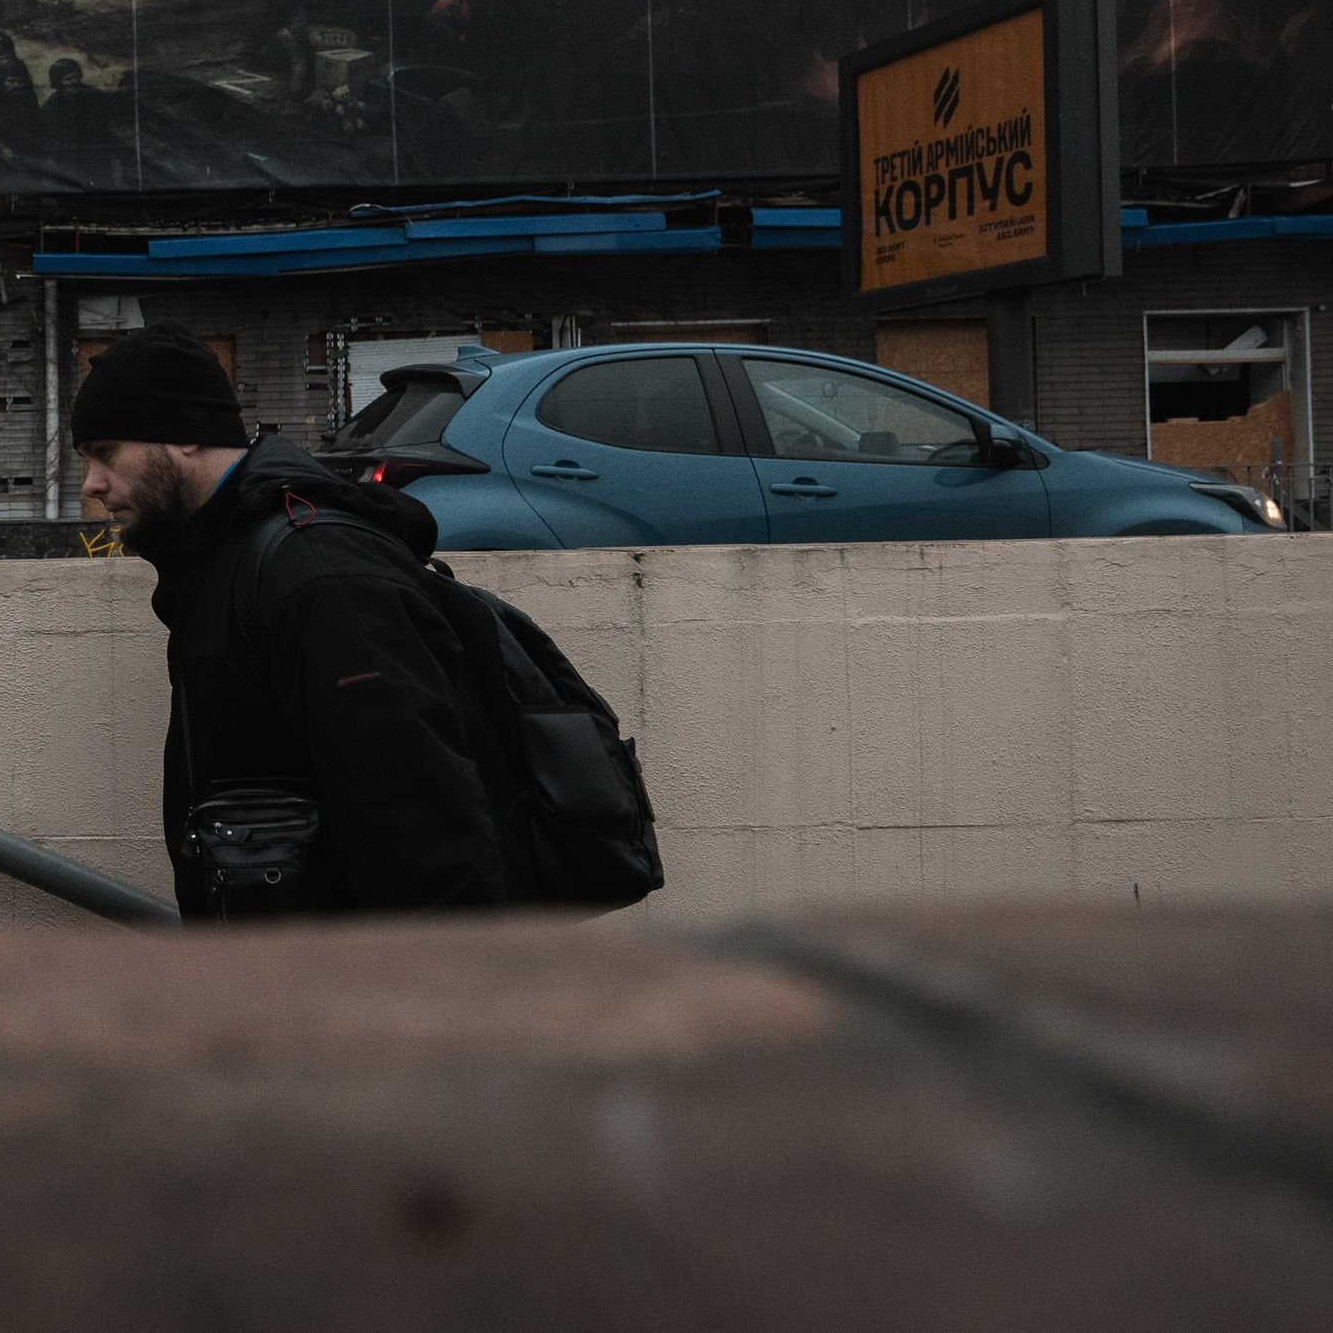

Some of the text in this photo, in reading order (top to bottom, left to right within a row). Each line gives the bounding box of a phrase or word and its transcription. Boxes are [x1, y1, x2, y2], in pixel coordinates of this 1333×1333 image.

[873, 107, 1031, 187] ТРЕТІЙ АРМІЙСЬКИЙ
[874, 150, 1033, 238] КОРПУС
